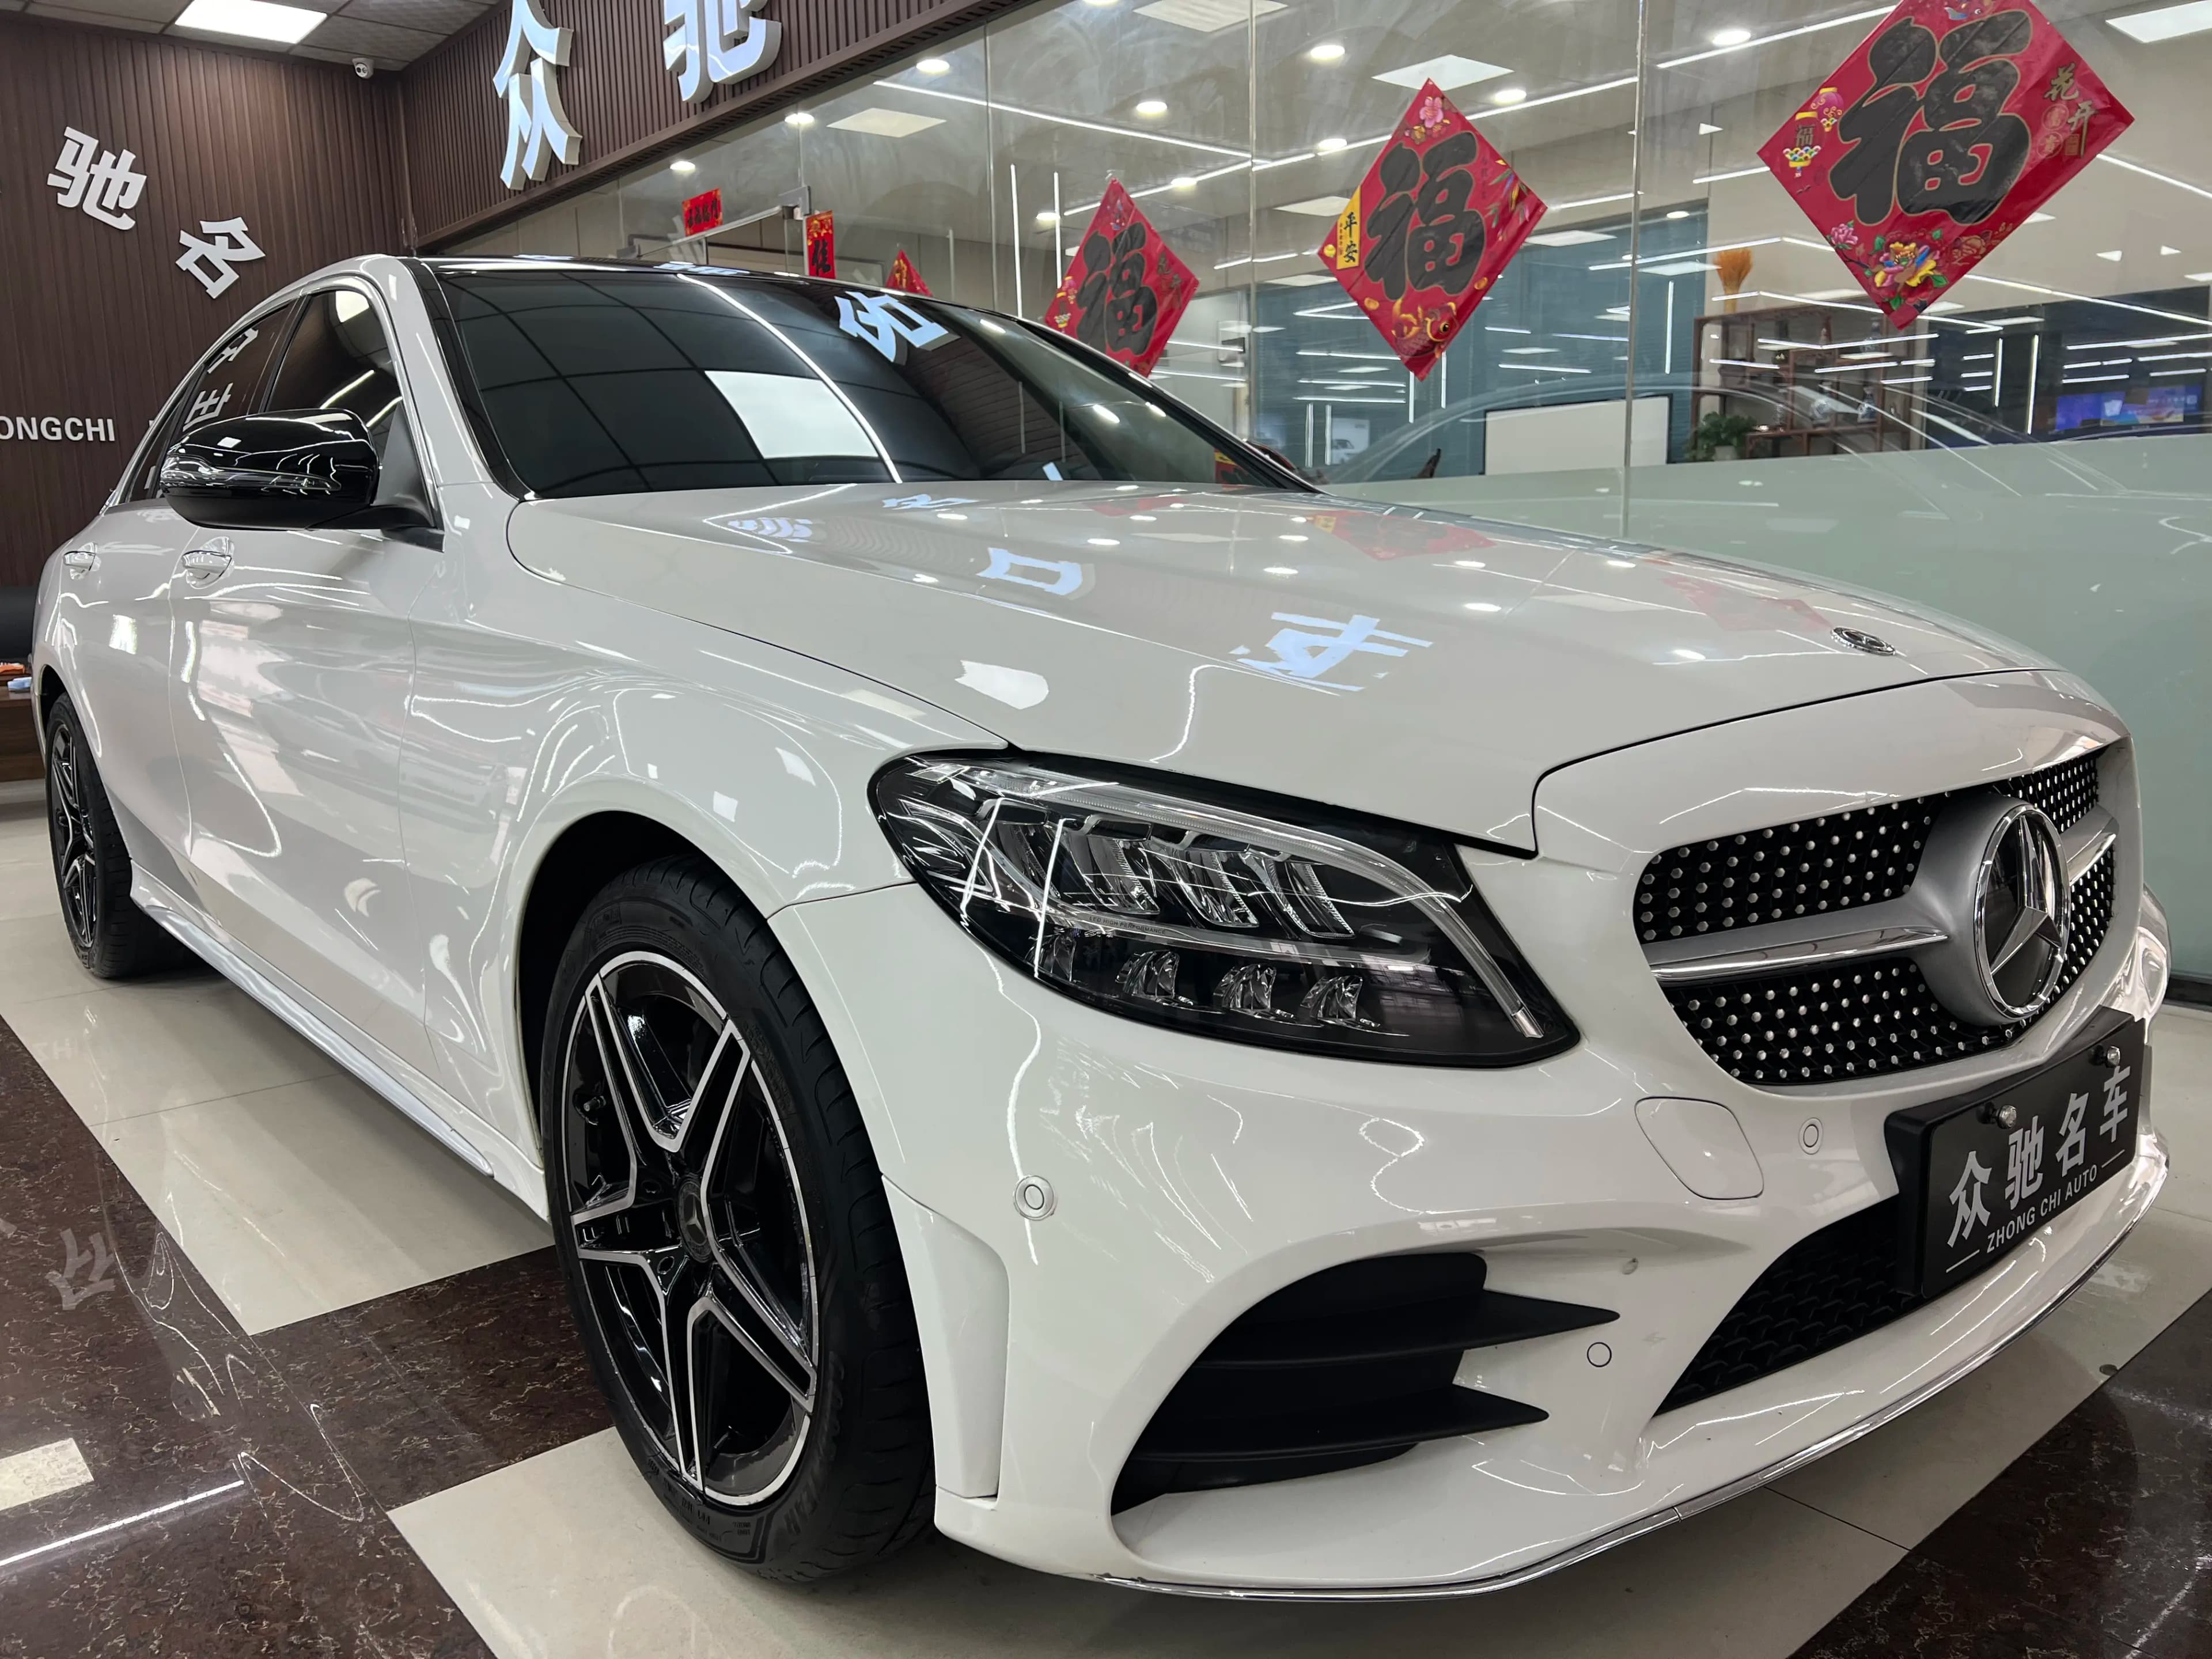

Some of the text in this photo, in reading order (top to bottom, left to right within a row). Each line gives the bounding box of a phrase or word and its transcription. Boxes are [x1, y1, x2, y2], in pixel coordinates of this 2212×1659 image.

[1829, 10, 2033, 226] 福
[1343, 211, 1358, 263] 平安
[1364, 131, 1486, 301] 福
[1077, 222, 1158, 356] 福
[1120, 922, 1166, 934] PERFORMANCE
[1947, 1065, 2130, 1248] 众驰名车
[1986, 1164, 2098, 1253] ZHONG CHI AUTO
